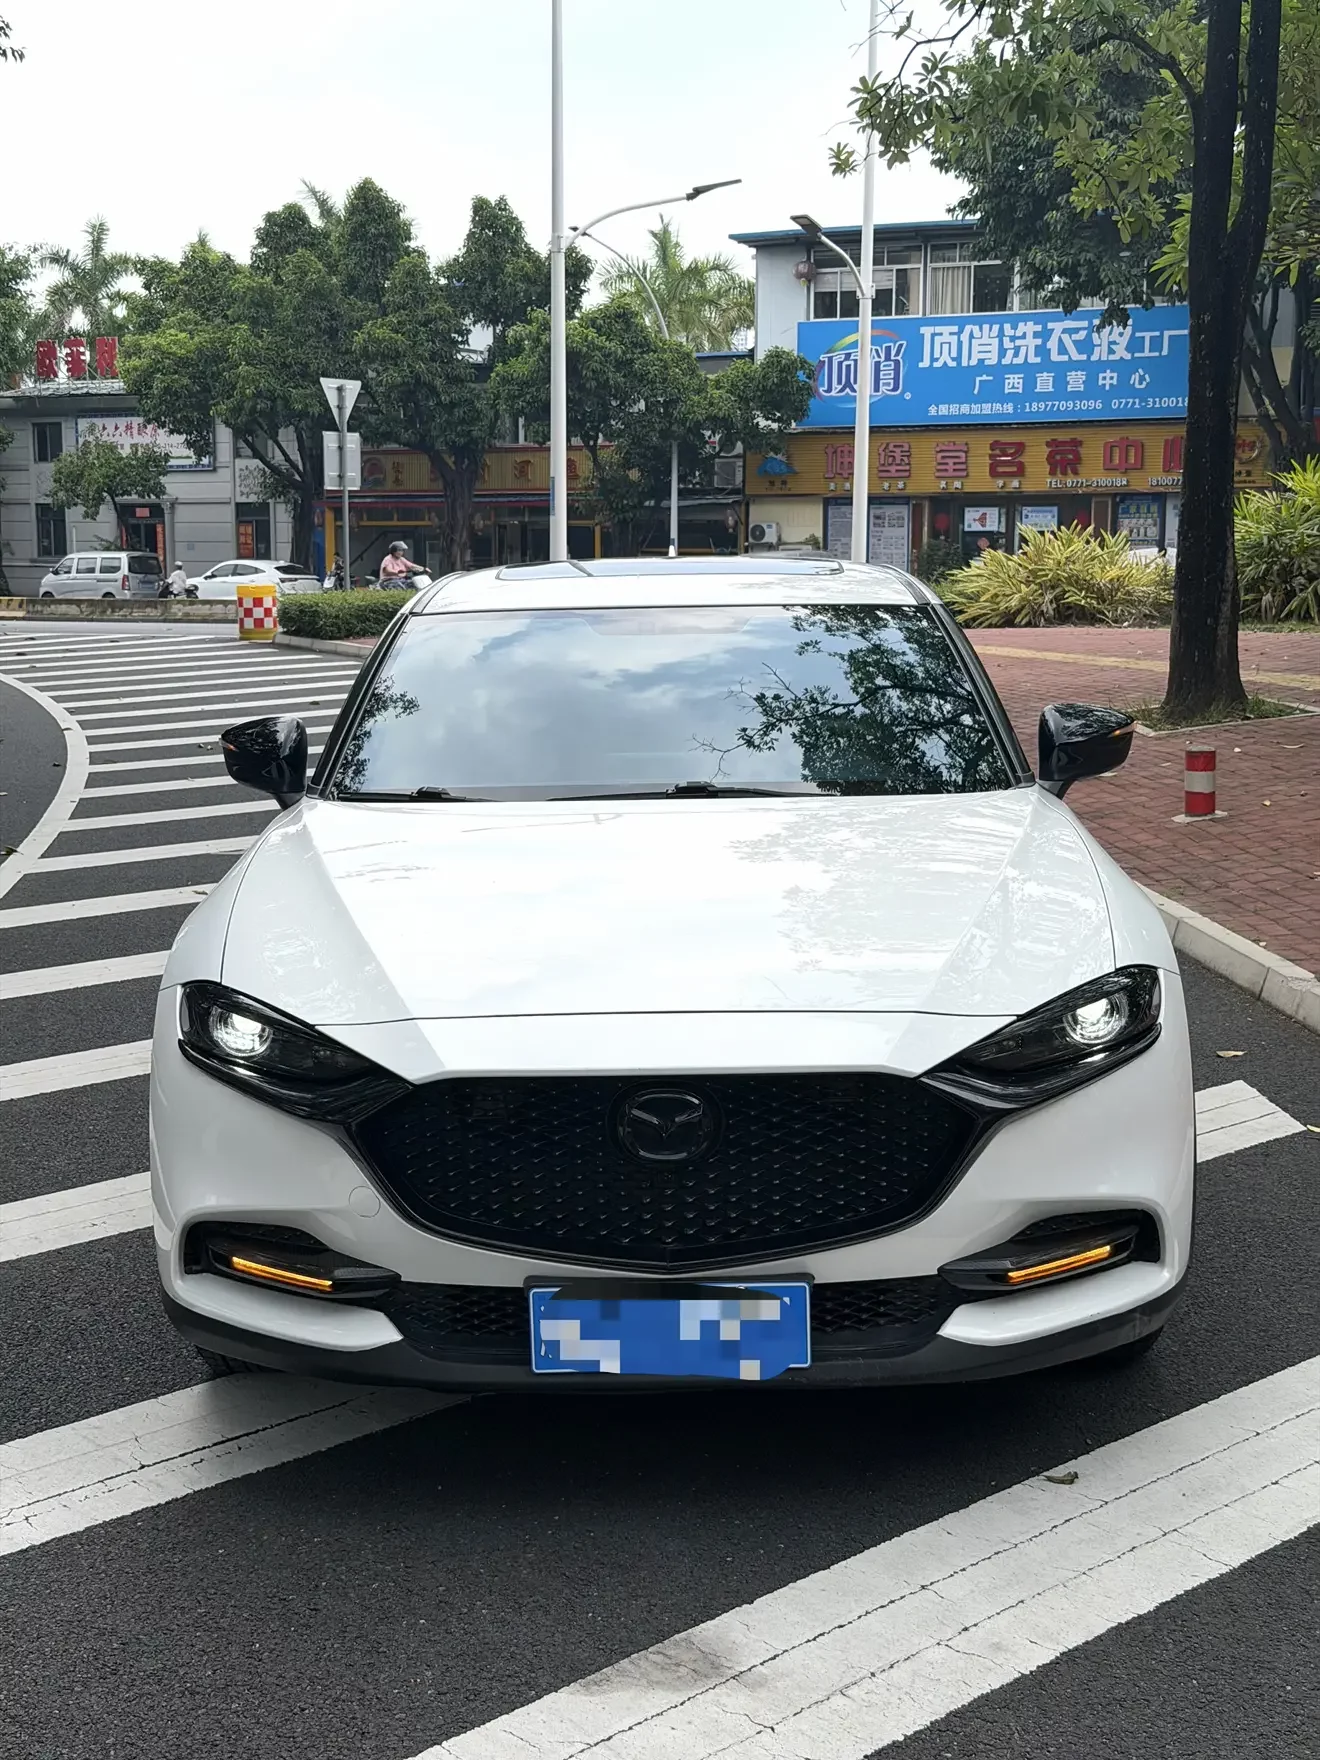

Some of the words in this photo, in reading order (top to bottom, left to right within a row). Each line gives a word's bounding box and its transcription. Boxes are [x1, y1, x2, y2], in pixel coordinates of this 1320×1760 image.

[918, 319, 1188, 368] 顶俏洗衣液工厂
[820, 341, 906, 396] 顶俏
[973, 368, 1150, 395] 广西直营中心
